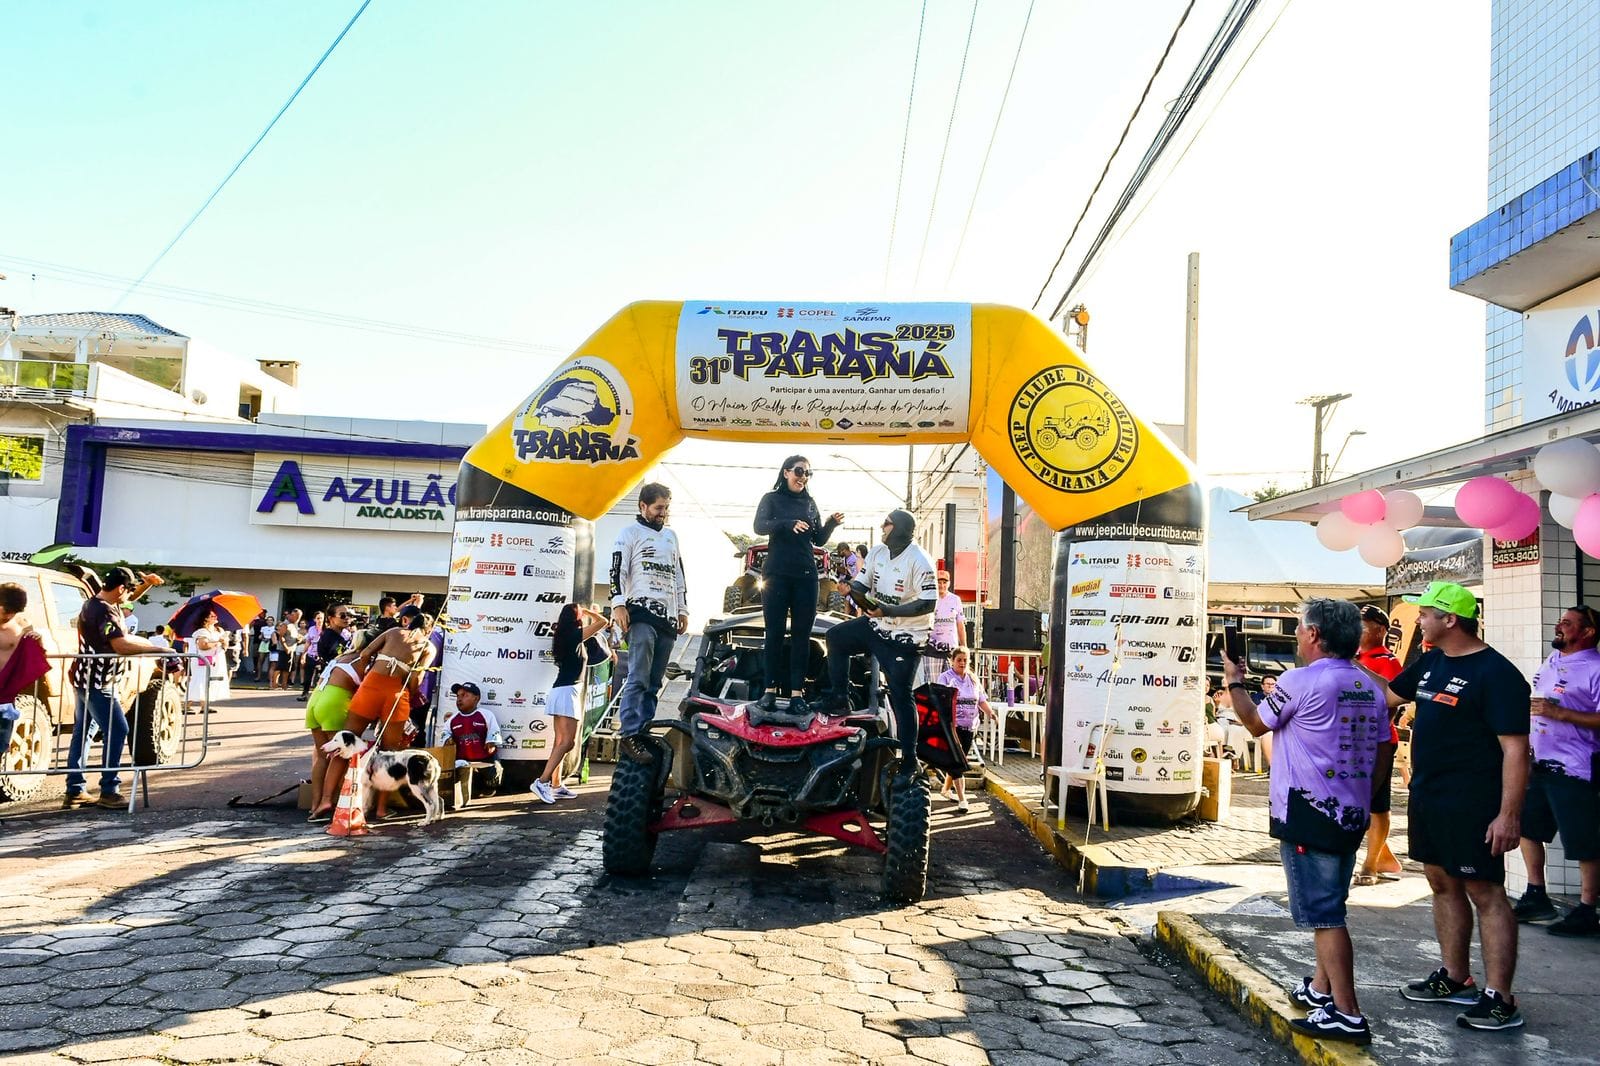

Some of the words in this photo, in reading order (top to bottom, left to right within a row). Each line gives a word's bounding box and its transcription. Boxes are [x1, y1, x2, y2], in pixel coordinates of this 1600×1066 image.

[895, 323, 955, 341] 2025
[717, 327, 899, 357] TRANS
[733, 341, 955, 384] PARANÁ
[1076, 370, 1095, 388] DE
[770, 386, 806, 395] Participar
[1018, 369, 1066, 410] CLUBE
[691, 396, 706, 412] O
[708, 397, 749, 413] Maior
[751, 397, 787, 416] Rally
[790, 399, 804, 413] de
[807, 398, 887, 417] Regularidade
[903, 399, 953, 415] Mundo
[1103, 391, 1134, 463] CURITIBA
[513, 428, 611, 447] TRANS
[1013, 421, 1036, 460] JEEP
[518, 438, 639, 464] PARANÁ
[356, 506, 445, 521] ATACADISTA
[463, 536, 485, 544] ITAIPU
[506, 537, 535, 547] COPEL
[1, 551, 32, 562] 3472-92
[1493, 550, 1539, 564] 3453-8400
[476, 563, 515, 571] DISPAUTO
[1072, 580, 1101, 594] Mundial
[1112, 586, 1155, 594] DISPAUTO
[474, 590, 528, 602] can-am
[535, 592, 566, 604] KTM
[487, 616, 523, 624] YOKOHAMA
[1110, 614, 1169, 626] can-am
[1128, 640, 1166, 649] YOKOHAMA
[497, 647, 533, 660] Mobil
[1124, 650, 1158, 659] TIRESHOP
[1143, 674, 1177, 688] Mobil
